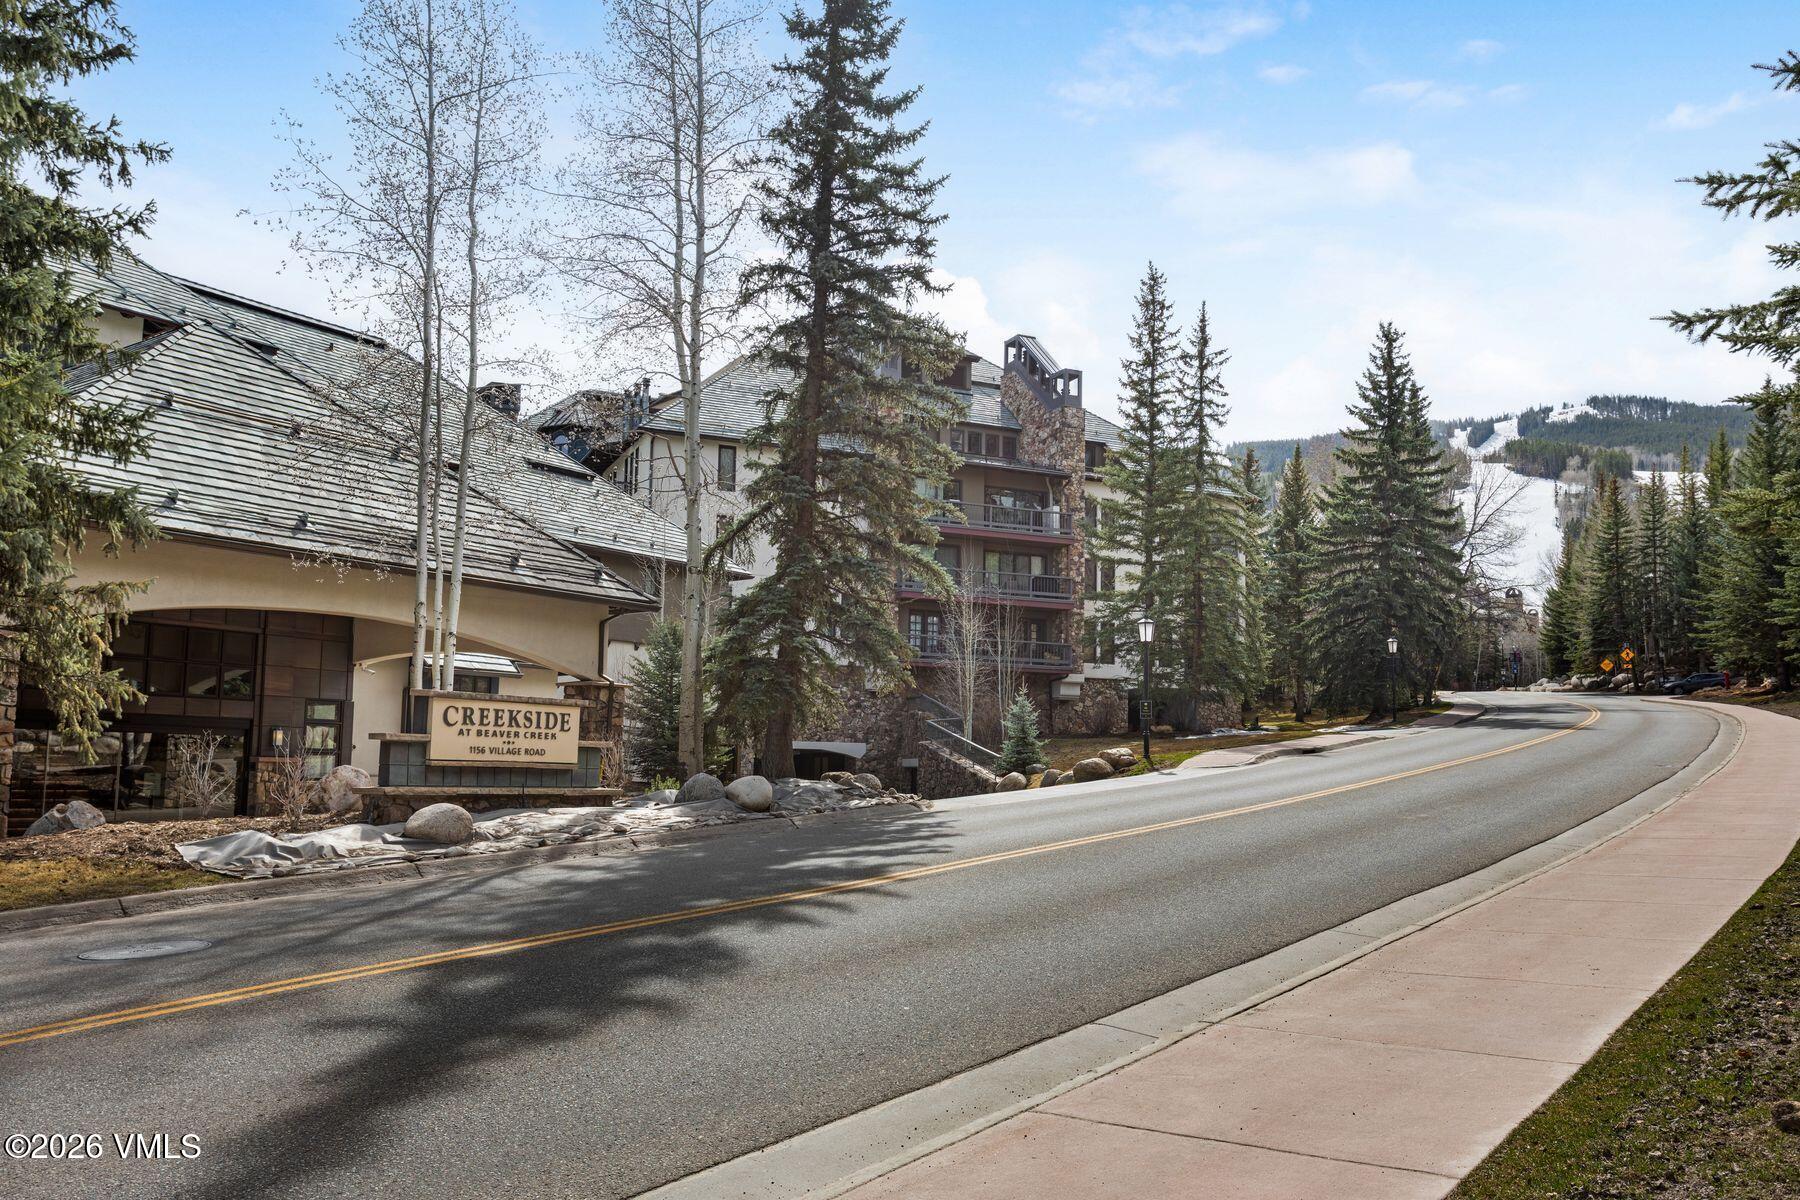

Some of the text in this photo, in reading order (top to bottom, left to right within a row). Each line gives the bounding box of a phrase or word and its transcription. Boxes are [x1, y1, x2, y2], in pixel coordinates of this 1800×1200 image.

[442, 705, 571, 732] CREEKSIDE
[457, 728, 557, 740] AT BEAVER CREEK
[469, 745, 546, 756] 1156 VILLAGE ROAD
